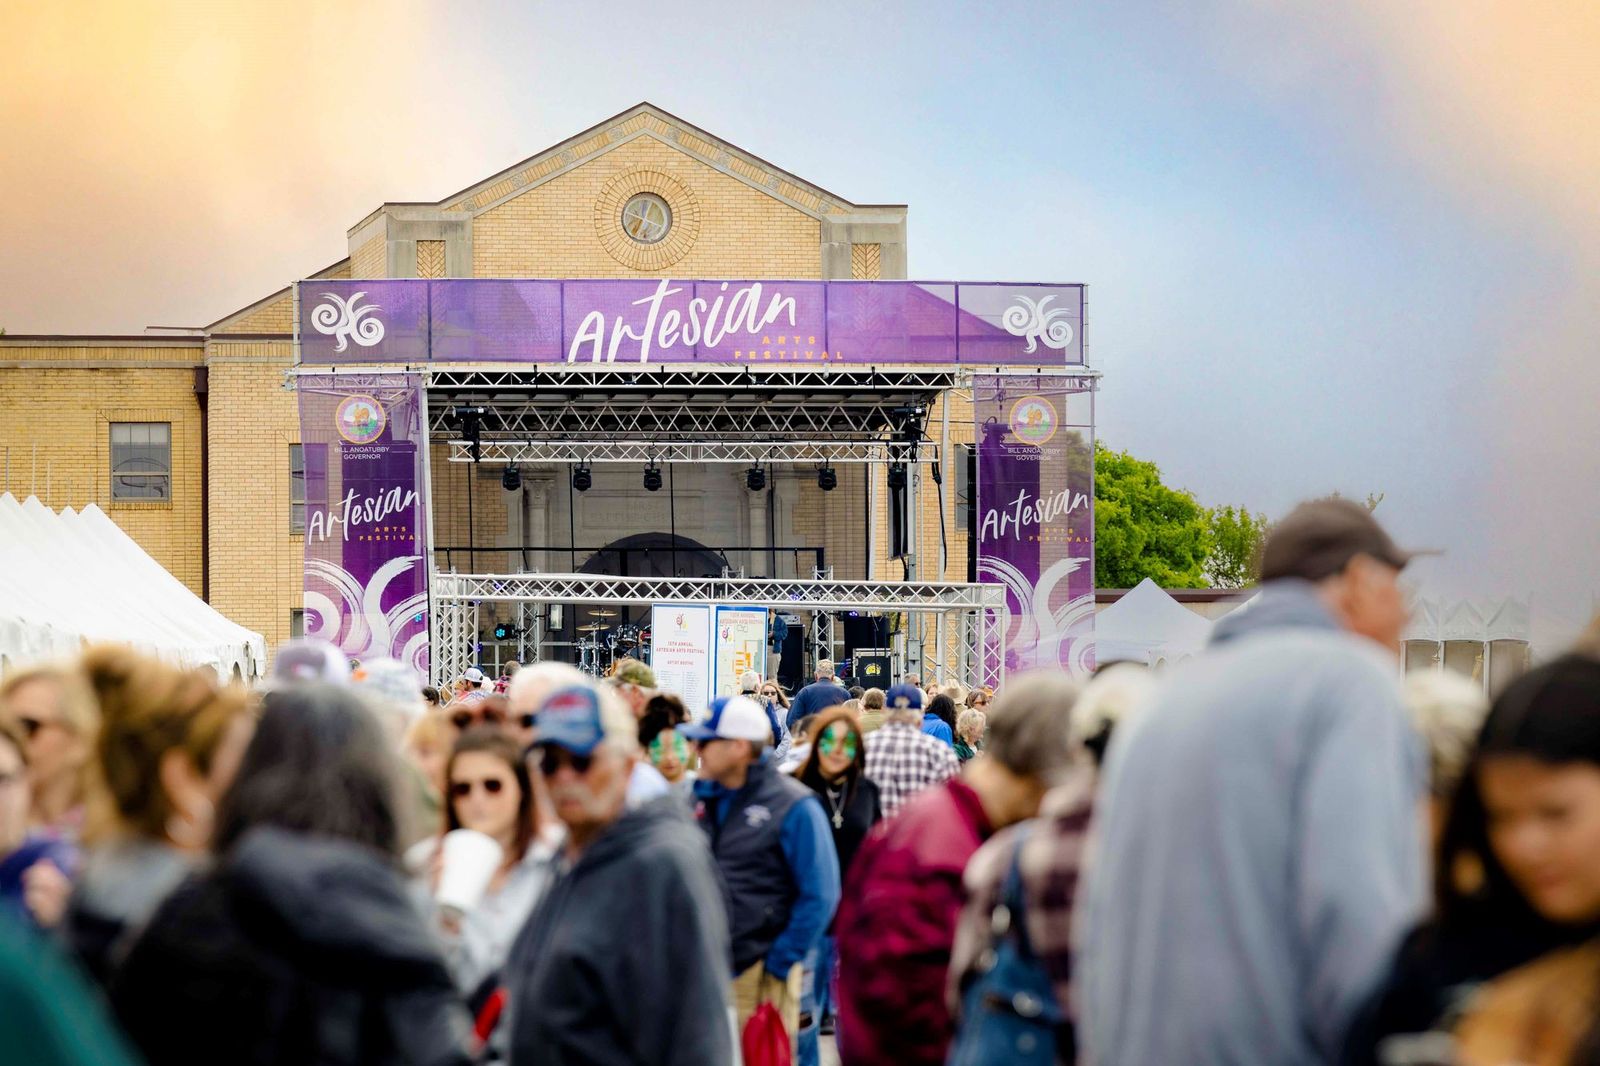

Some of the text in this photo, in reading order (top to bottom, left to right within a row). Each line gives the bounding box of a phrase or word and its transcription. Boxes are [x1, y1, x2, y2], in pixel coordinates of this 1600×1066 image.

[567, 279, 796, 363] Artesian
[761, 335, 817, 345] ARTS
[733, 351, 844, 360] FESTIVAL
[308, 486, 421, 546] Artesian
[981, 488, 1088, 542] Artesian
